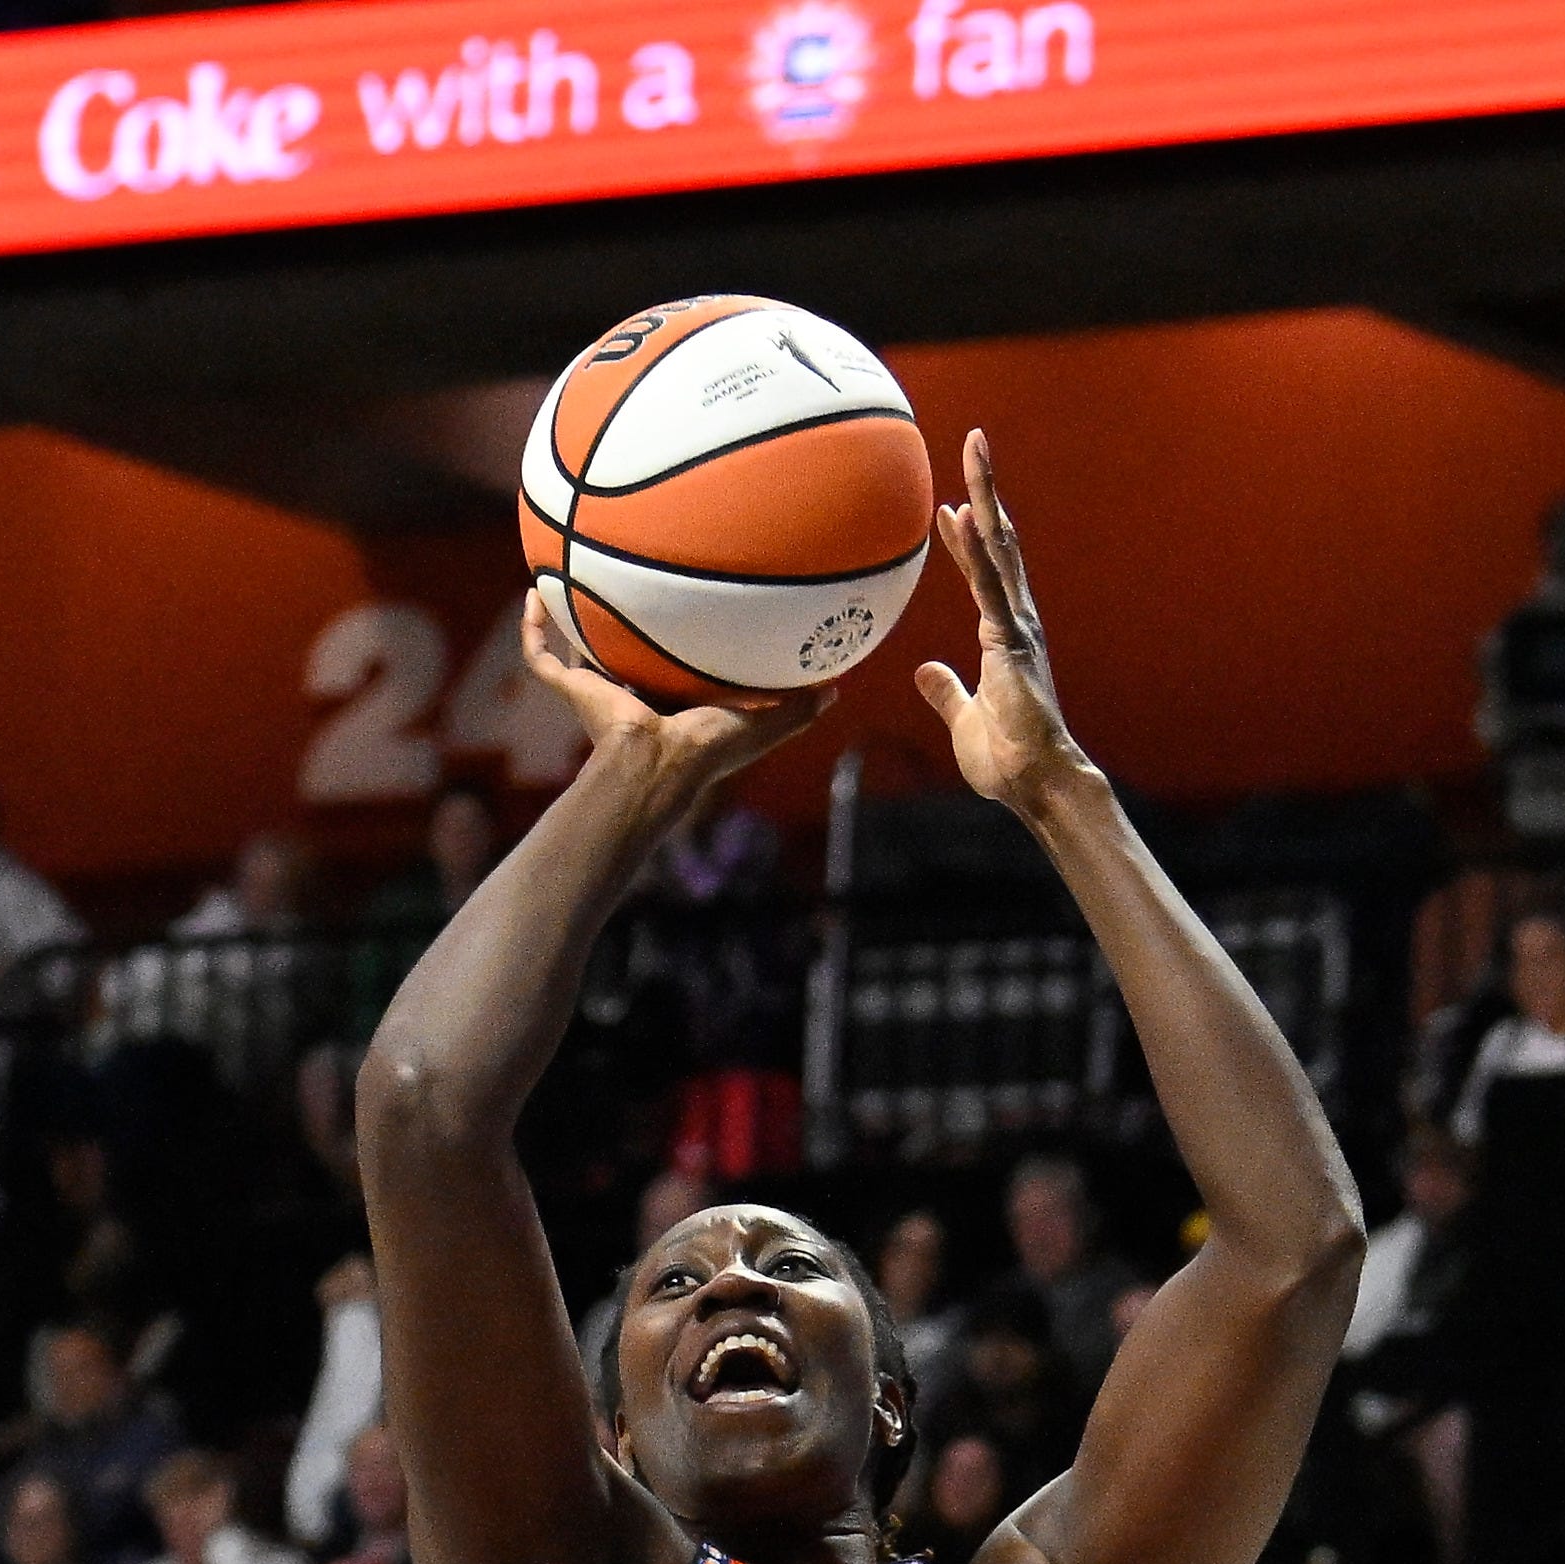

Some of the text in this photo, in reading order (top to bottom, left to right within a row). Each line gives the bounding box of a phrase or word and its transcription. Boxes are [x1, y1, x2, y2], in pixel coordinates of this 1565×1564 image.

[38, 61, 323, 201] Coke
[357, 28, 599, 154] with
[622, 41, 699, 131] a
[908, 0, 1095, 99] fan
[700, 381, 743, 408] GAME
[743, 368, 780, 387] BALL
